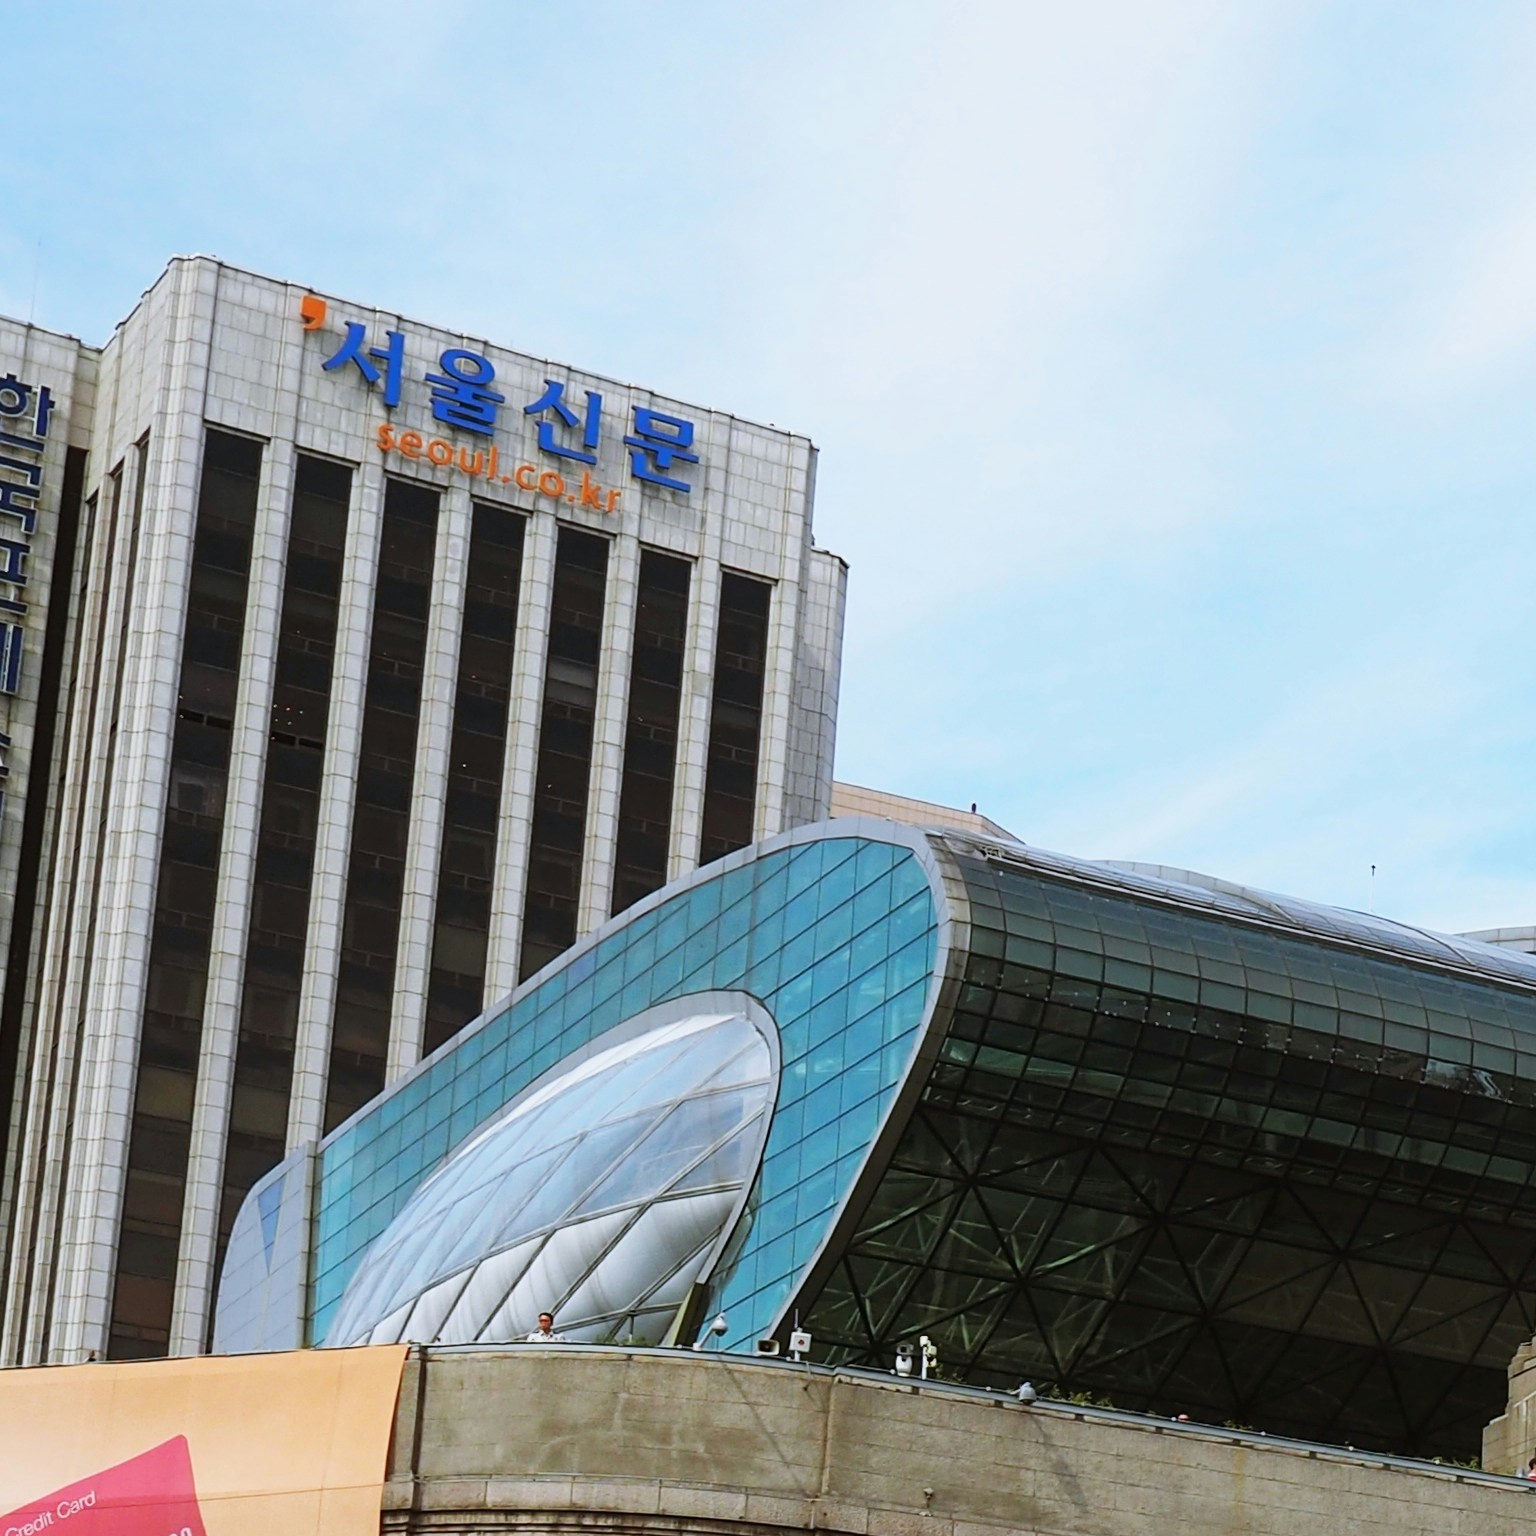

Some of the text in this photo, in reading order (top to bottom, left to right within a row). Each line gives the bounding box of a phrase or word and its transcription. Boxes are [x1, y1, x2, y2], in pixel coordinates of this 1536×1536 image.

[322, 320, 700, 493] 서울신문
[376, 422, 623, 514] seoul.co.kr
[56, 1489, 98, 1521] Card
